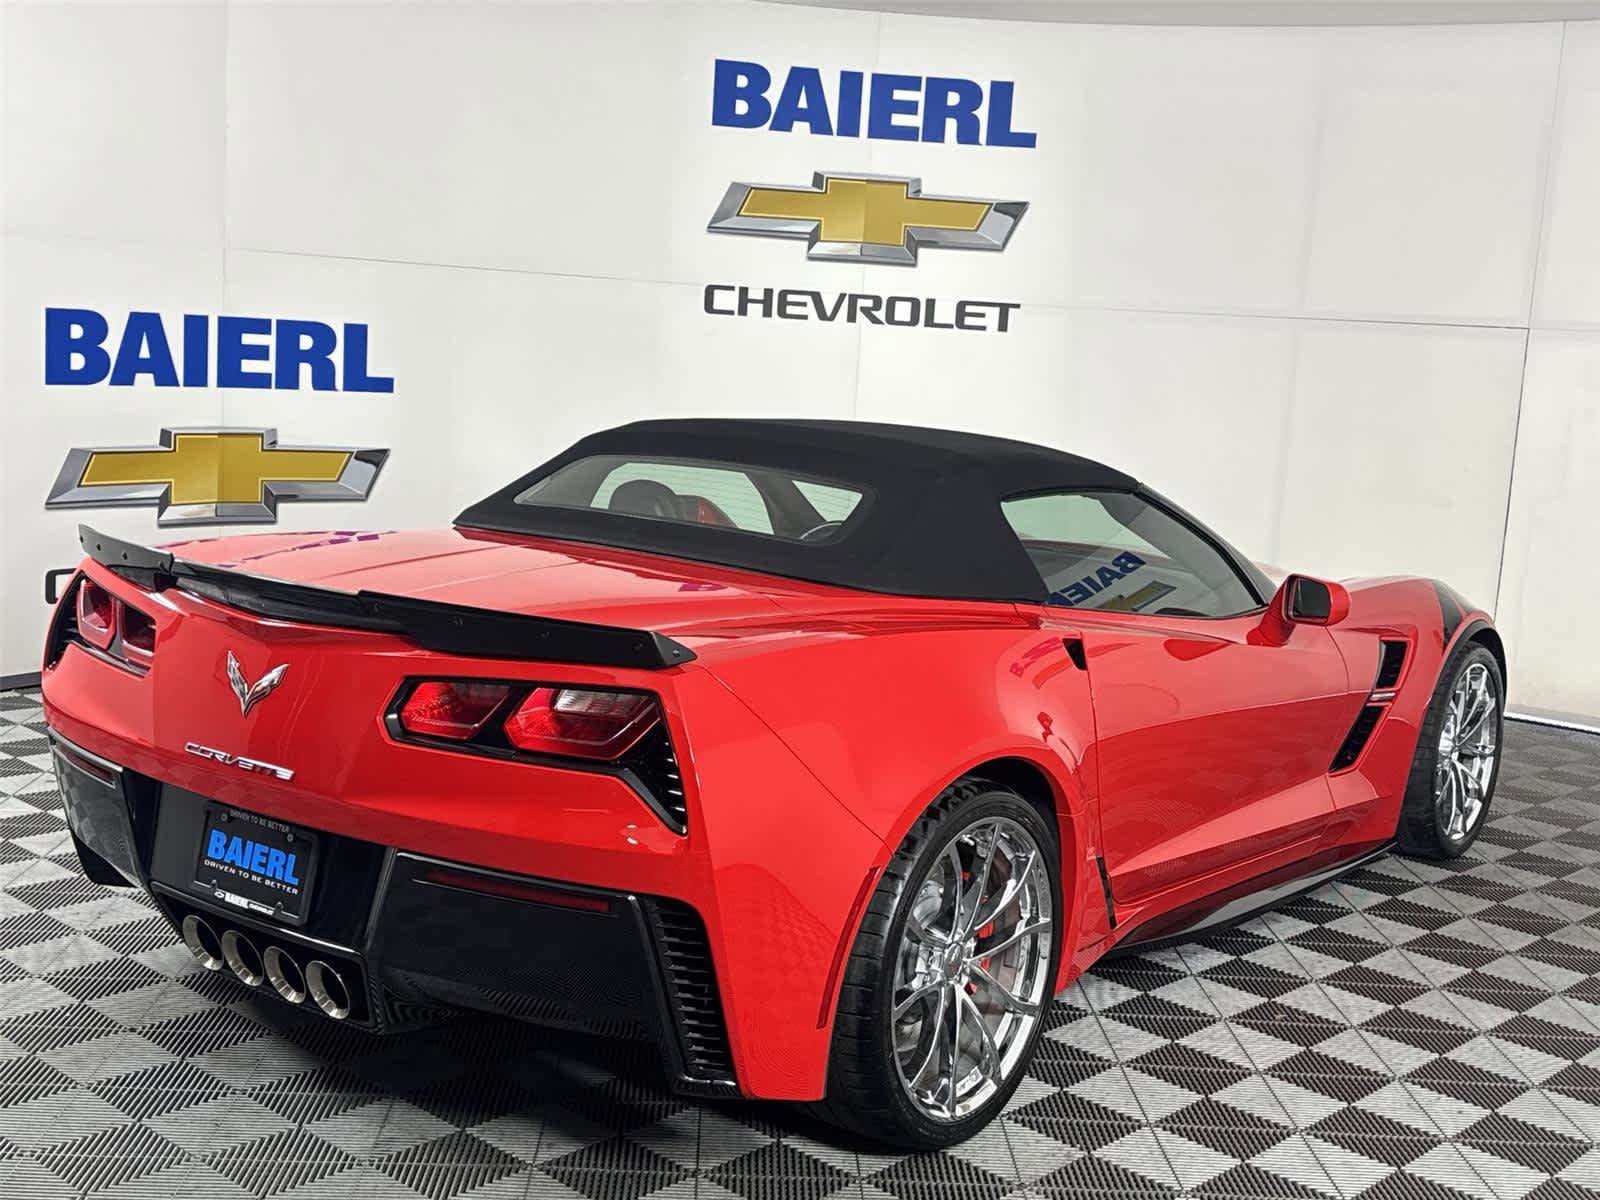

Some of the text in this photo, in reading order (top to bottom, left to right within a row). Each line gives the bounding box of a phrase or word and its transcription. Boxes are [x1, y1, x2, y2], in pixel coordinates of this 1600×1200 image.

[711, 58, 1038, 149] BAIERL
[704, 284, 1021, 332] CHEVROLET
[45, 307, 394, 393] BAIERL
[184, 741, 295, 781] CORVETTE
[204, 859, 299, 896] DRIVEN TO BE BETTER
[207, 829, 299, 886] BAIERL
